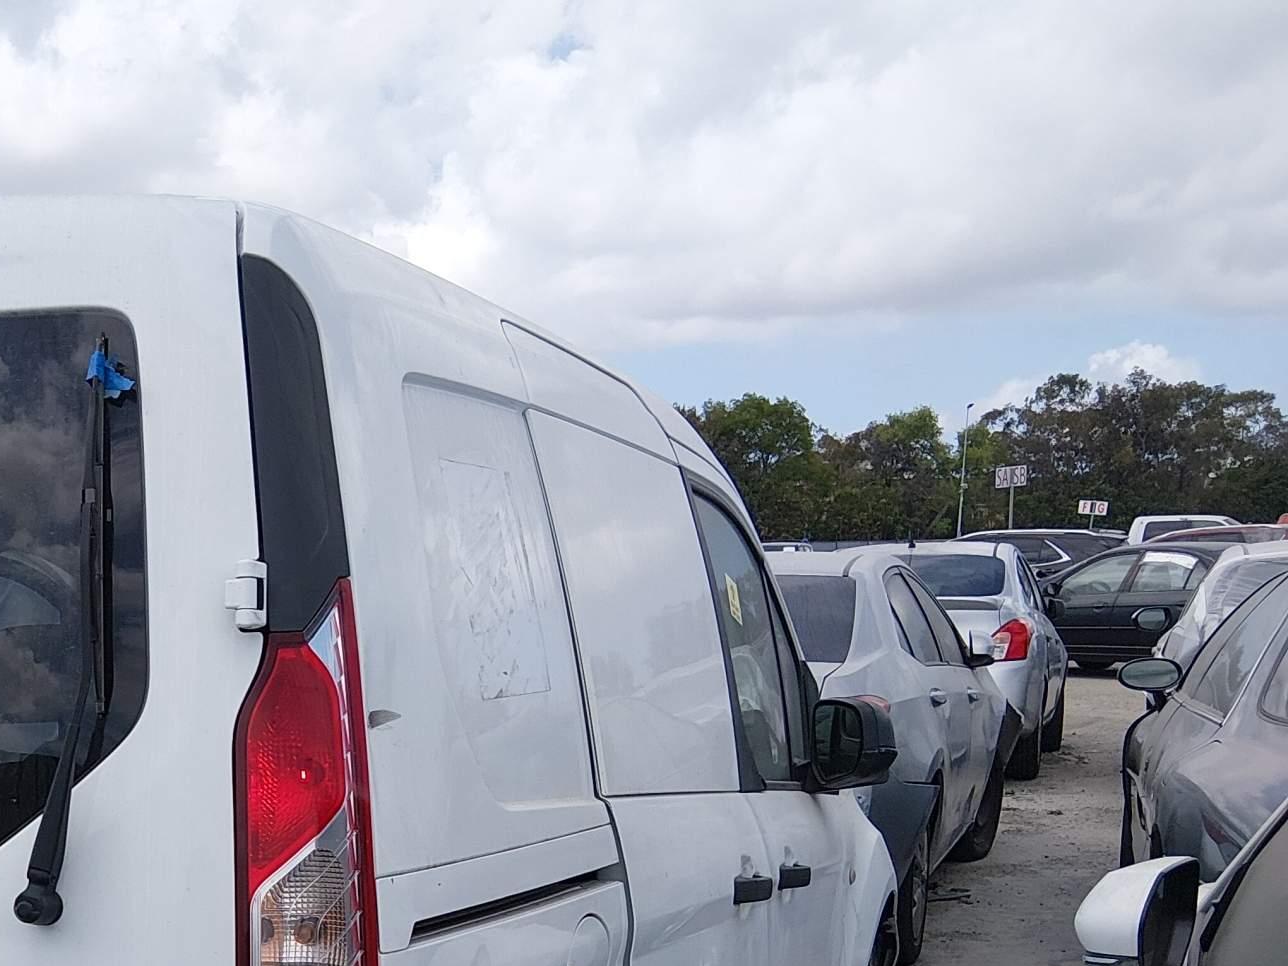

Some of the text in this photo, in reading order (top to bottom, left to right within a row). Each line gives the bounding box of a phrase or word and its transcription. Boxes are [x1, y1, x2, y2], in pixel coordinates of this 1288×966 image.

[997, 467, 1026, 487] SA SB
[1097, 503, 1105, 514] G
